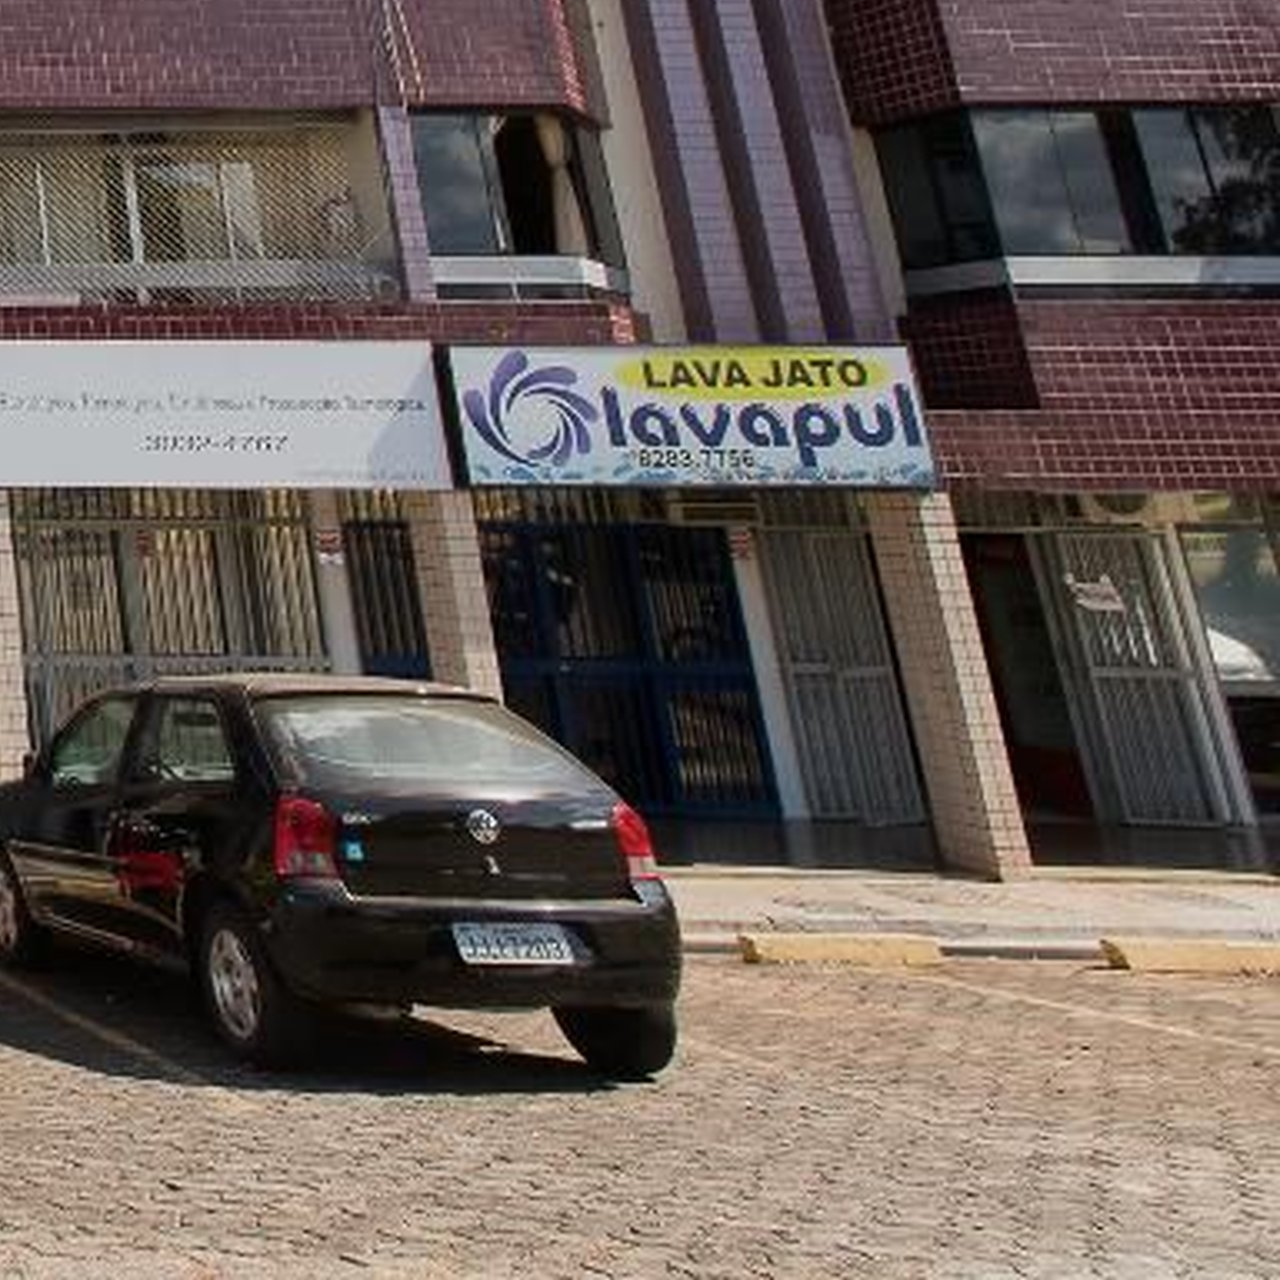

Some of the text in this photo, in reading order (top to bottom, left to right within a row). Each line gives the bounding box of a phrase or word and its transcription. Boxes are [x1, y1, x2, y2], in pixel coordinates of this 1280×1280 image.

[642, 359, 868, 388] LAVA JATO
[600, 382, 923, 467] lavapul
